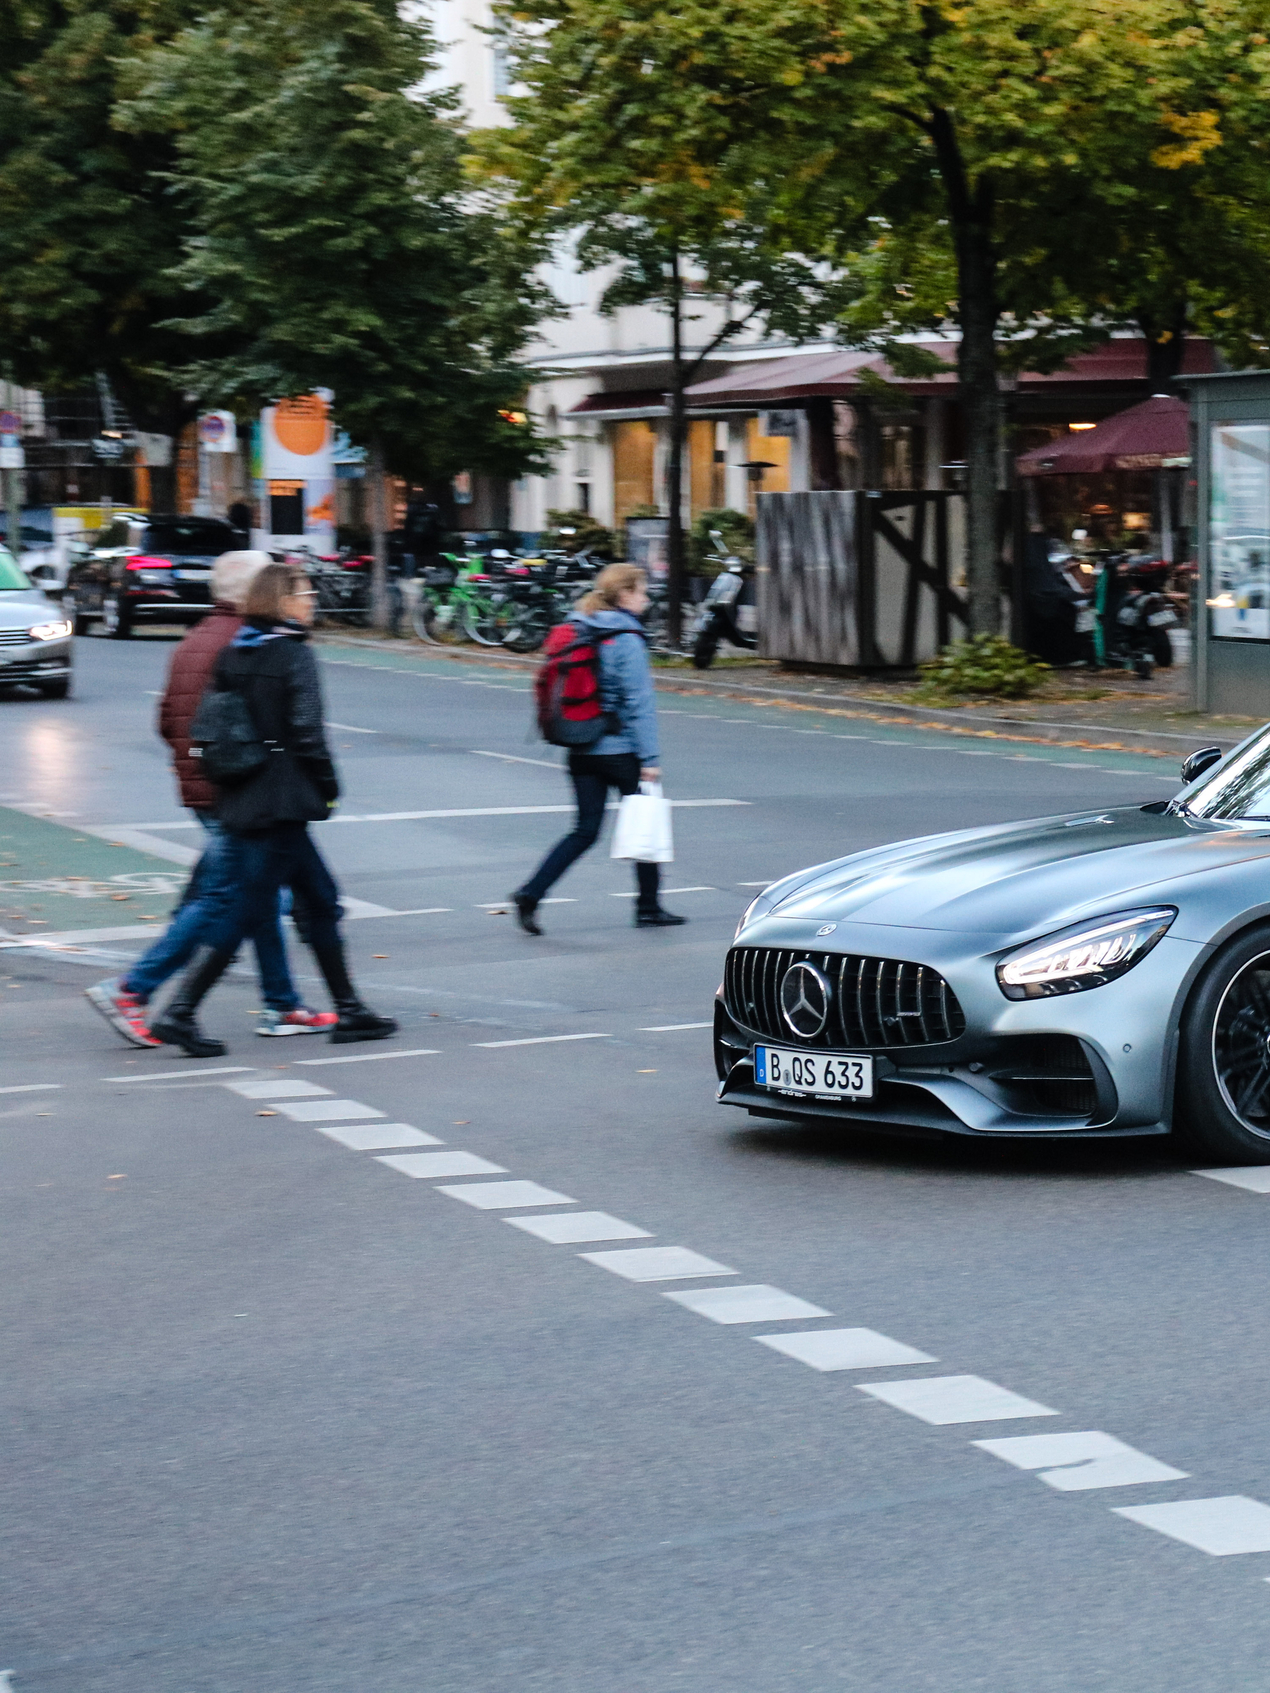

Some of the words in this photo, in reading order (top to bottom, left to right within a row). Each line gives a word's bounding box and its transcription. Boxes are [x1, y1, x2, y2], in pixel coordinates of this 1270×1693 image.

[771, 1053, 781, 1082] B
[792, 1056, 816, 1087] QS
[824, 1060, 863, 1091] 633
